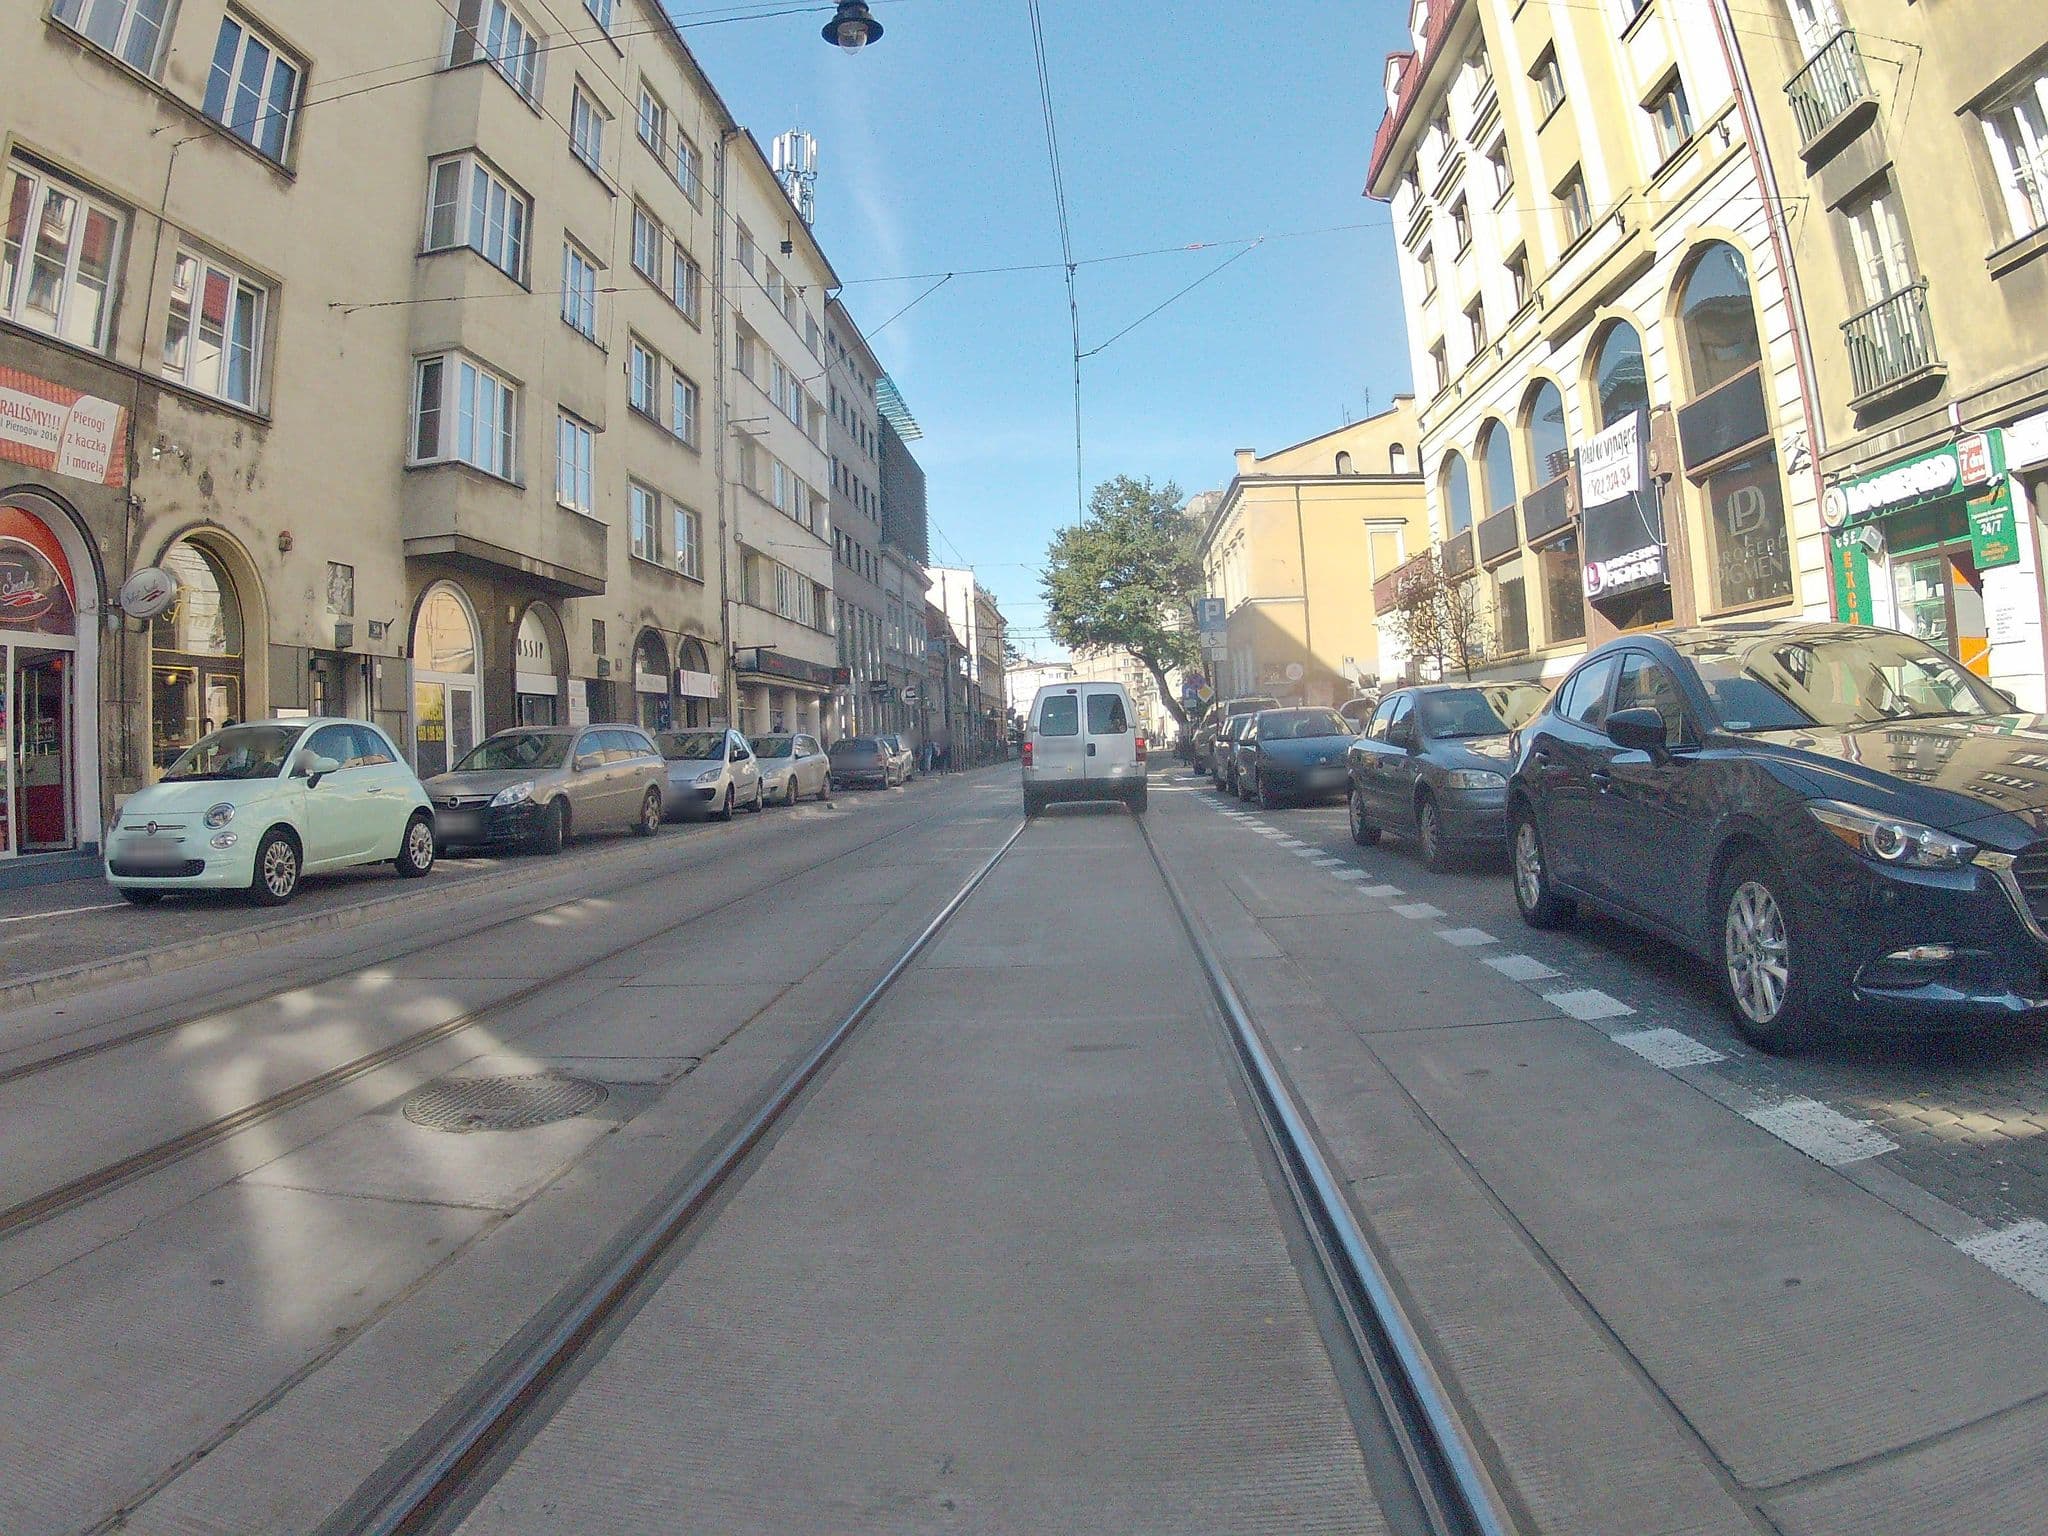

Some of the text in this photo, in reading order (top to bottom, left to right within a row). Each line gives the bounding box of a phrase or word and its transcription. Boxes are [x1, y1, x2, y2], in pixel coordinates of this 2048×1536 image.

[73, 410, 106, 434] Pierogi
[40, 429, 58, 442] 2016
[67, 432, 107, 457] z kaczką
[72, 456, 104, 478] morelą
[1205, 601, 1220, 622] P
